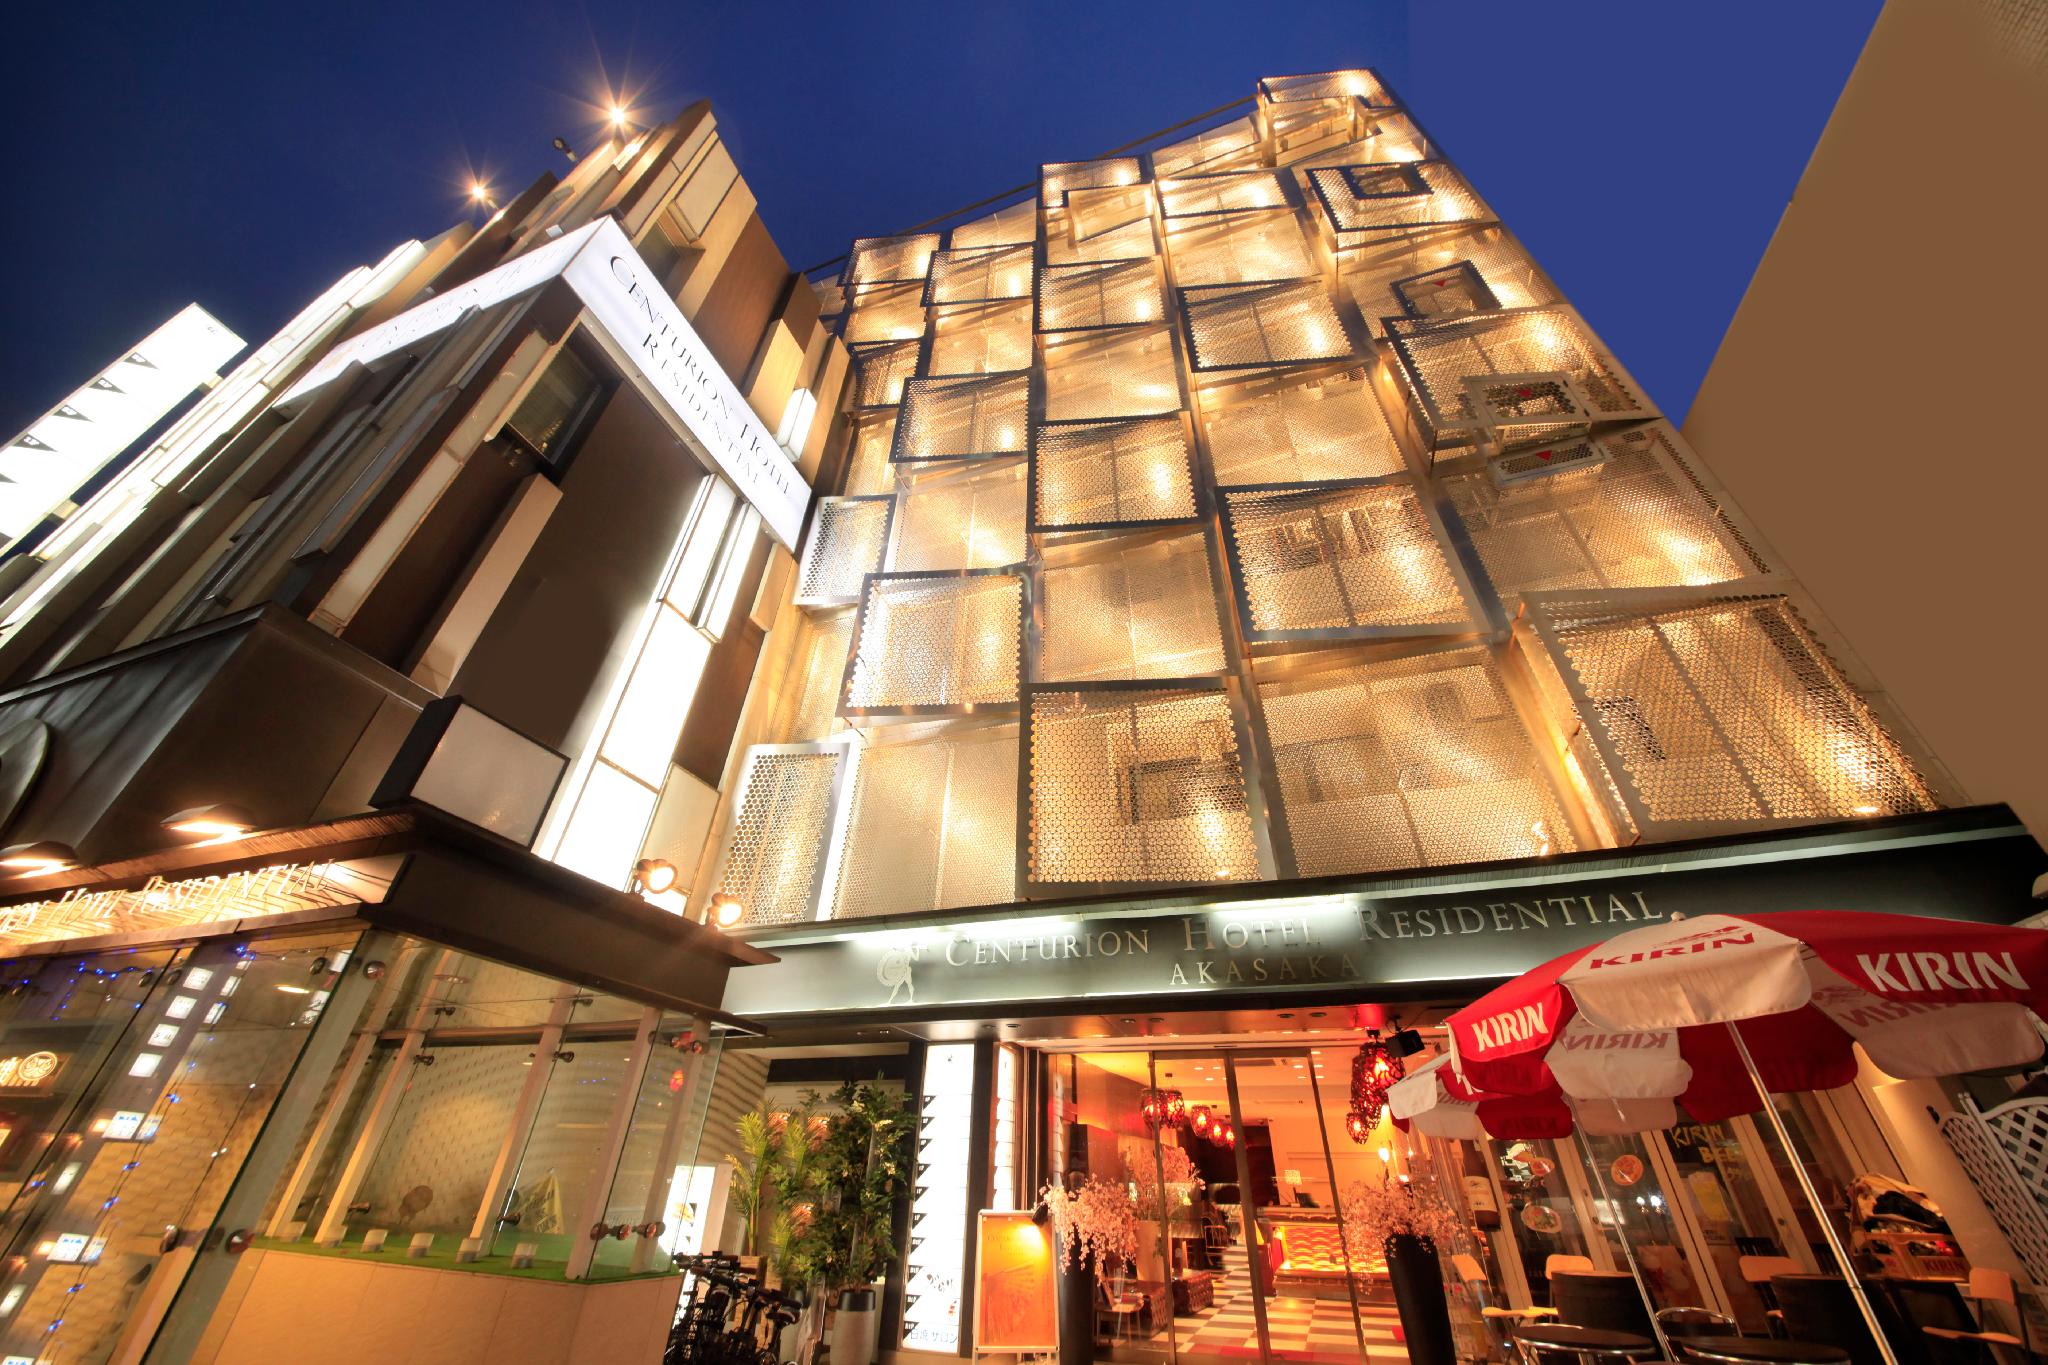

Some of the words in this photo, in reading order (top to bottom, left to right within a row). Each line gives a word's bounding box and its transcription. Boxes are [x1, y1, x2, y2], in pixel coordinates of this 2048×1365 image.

[610, 255, 733, 420] CENTURION
[945, 929, 1150, 967] CENTURION
[1182, 916, 1321, 951] HOTEL
[1353, 891, 1663, 942] RESIDENTIAL
[1169, 953, 1361, 986] AKASAKA
[1590, 932, 1755, 970] KIRIN
[1856, 951, 2031, 992] KIRIN
[1471, 1002, 1549, 1053] KIRIN
[1669, 1124, 1727, 1148] KIRIN
